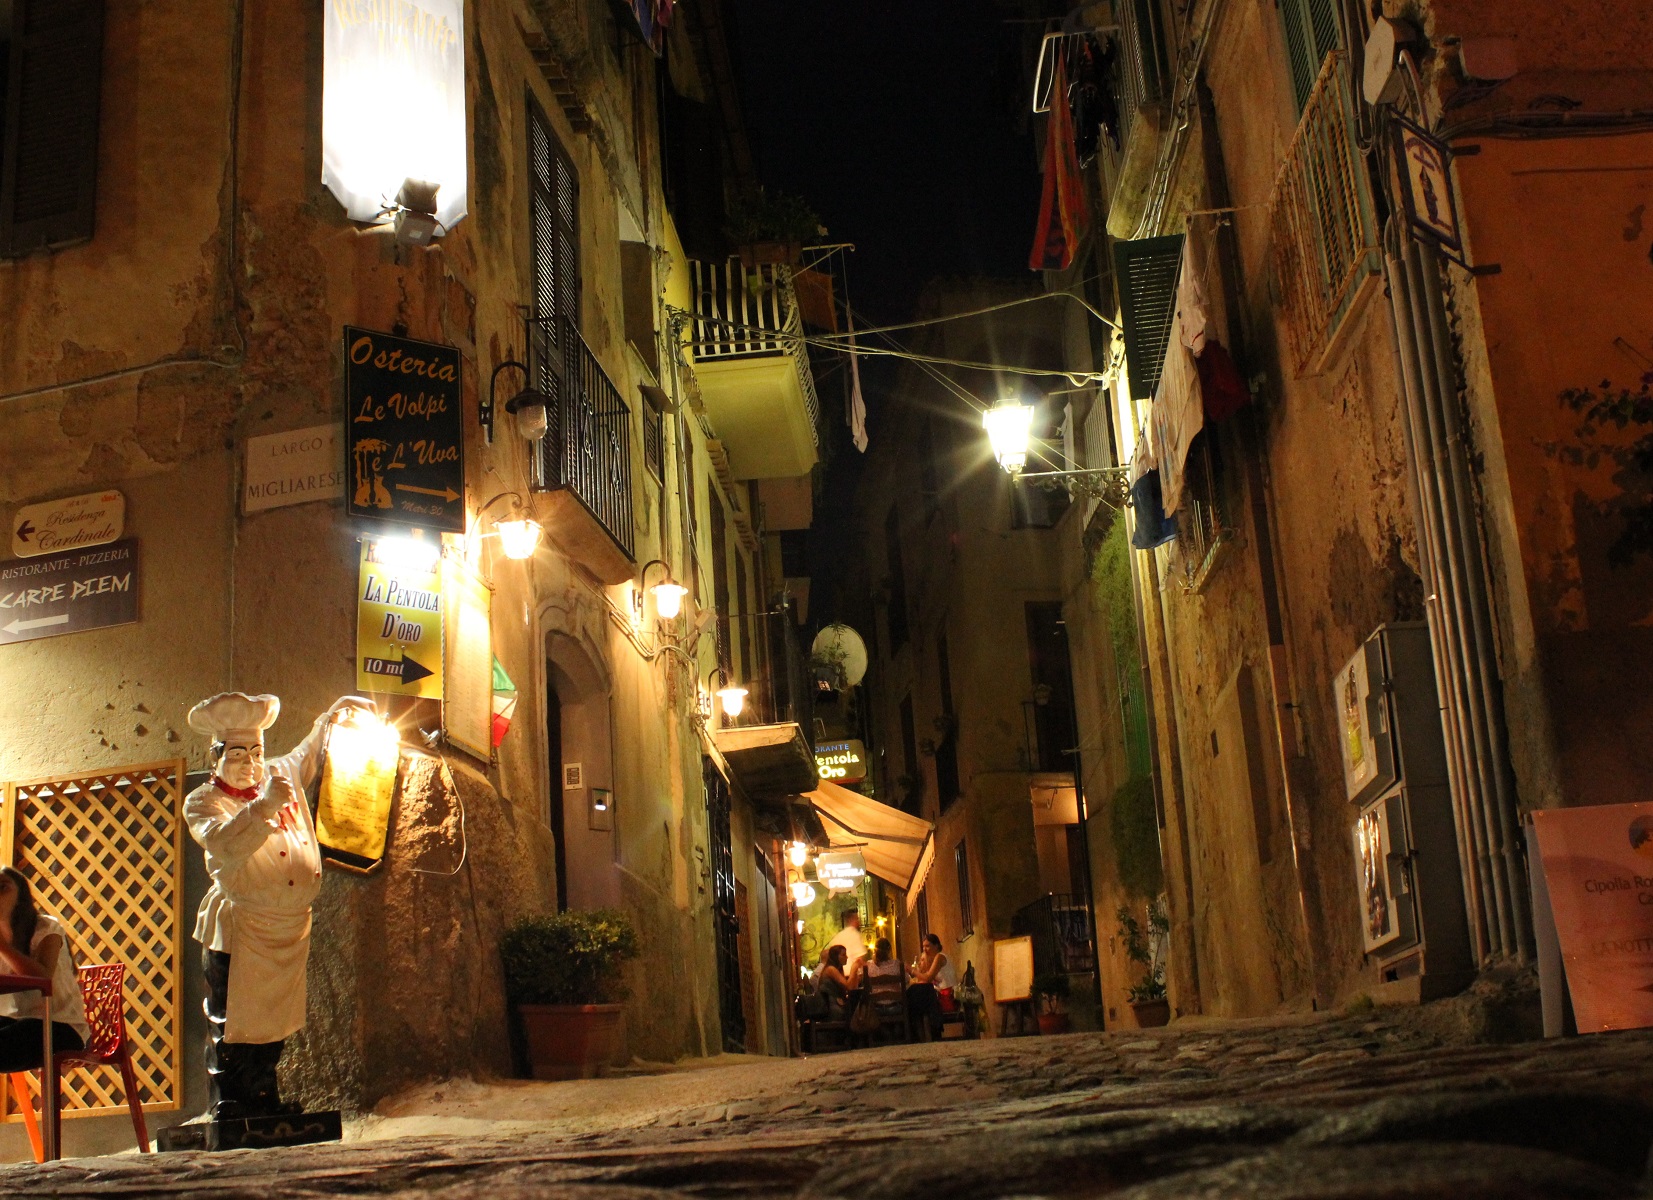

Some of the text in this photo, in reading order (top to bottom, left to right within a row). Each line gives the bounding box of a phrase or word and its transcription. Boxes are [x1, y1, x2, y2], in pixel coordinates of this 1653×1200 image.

[350, 336, 457, 383] Osteria
[354, 392, 448, 423] Le Volpi
[271, 438, 322, 456] LARGO
[372, 440, 459, 471] e L'Uva
[248, 471, 343, 498] MIGLIARESE
[46, 509, 106, 527] Residenza
[430, 505, 444, 516] 30
[36, 523, 116, 550] Cardinale
[2, 559, 71, 580] RISTORANTE
[79, 548, 130, 567] PIZZERIA
[0, 572, 131, 608] CARPE DIEM
[364, 576, 439, 611] LA PENTOLA
[381, 613, 421, 642] D'ORO
[365, 659, 382, 673] 10
[815, 751, 859, 767] entola
[1584, 875, 1653, 895] Cipolla Ro
